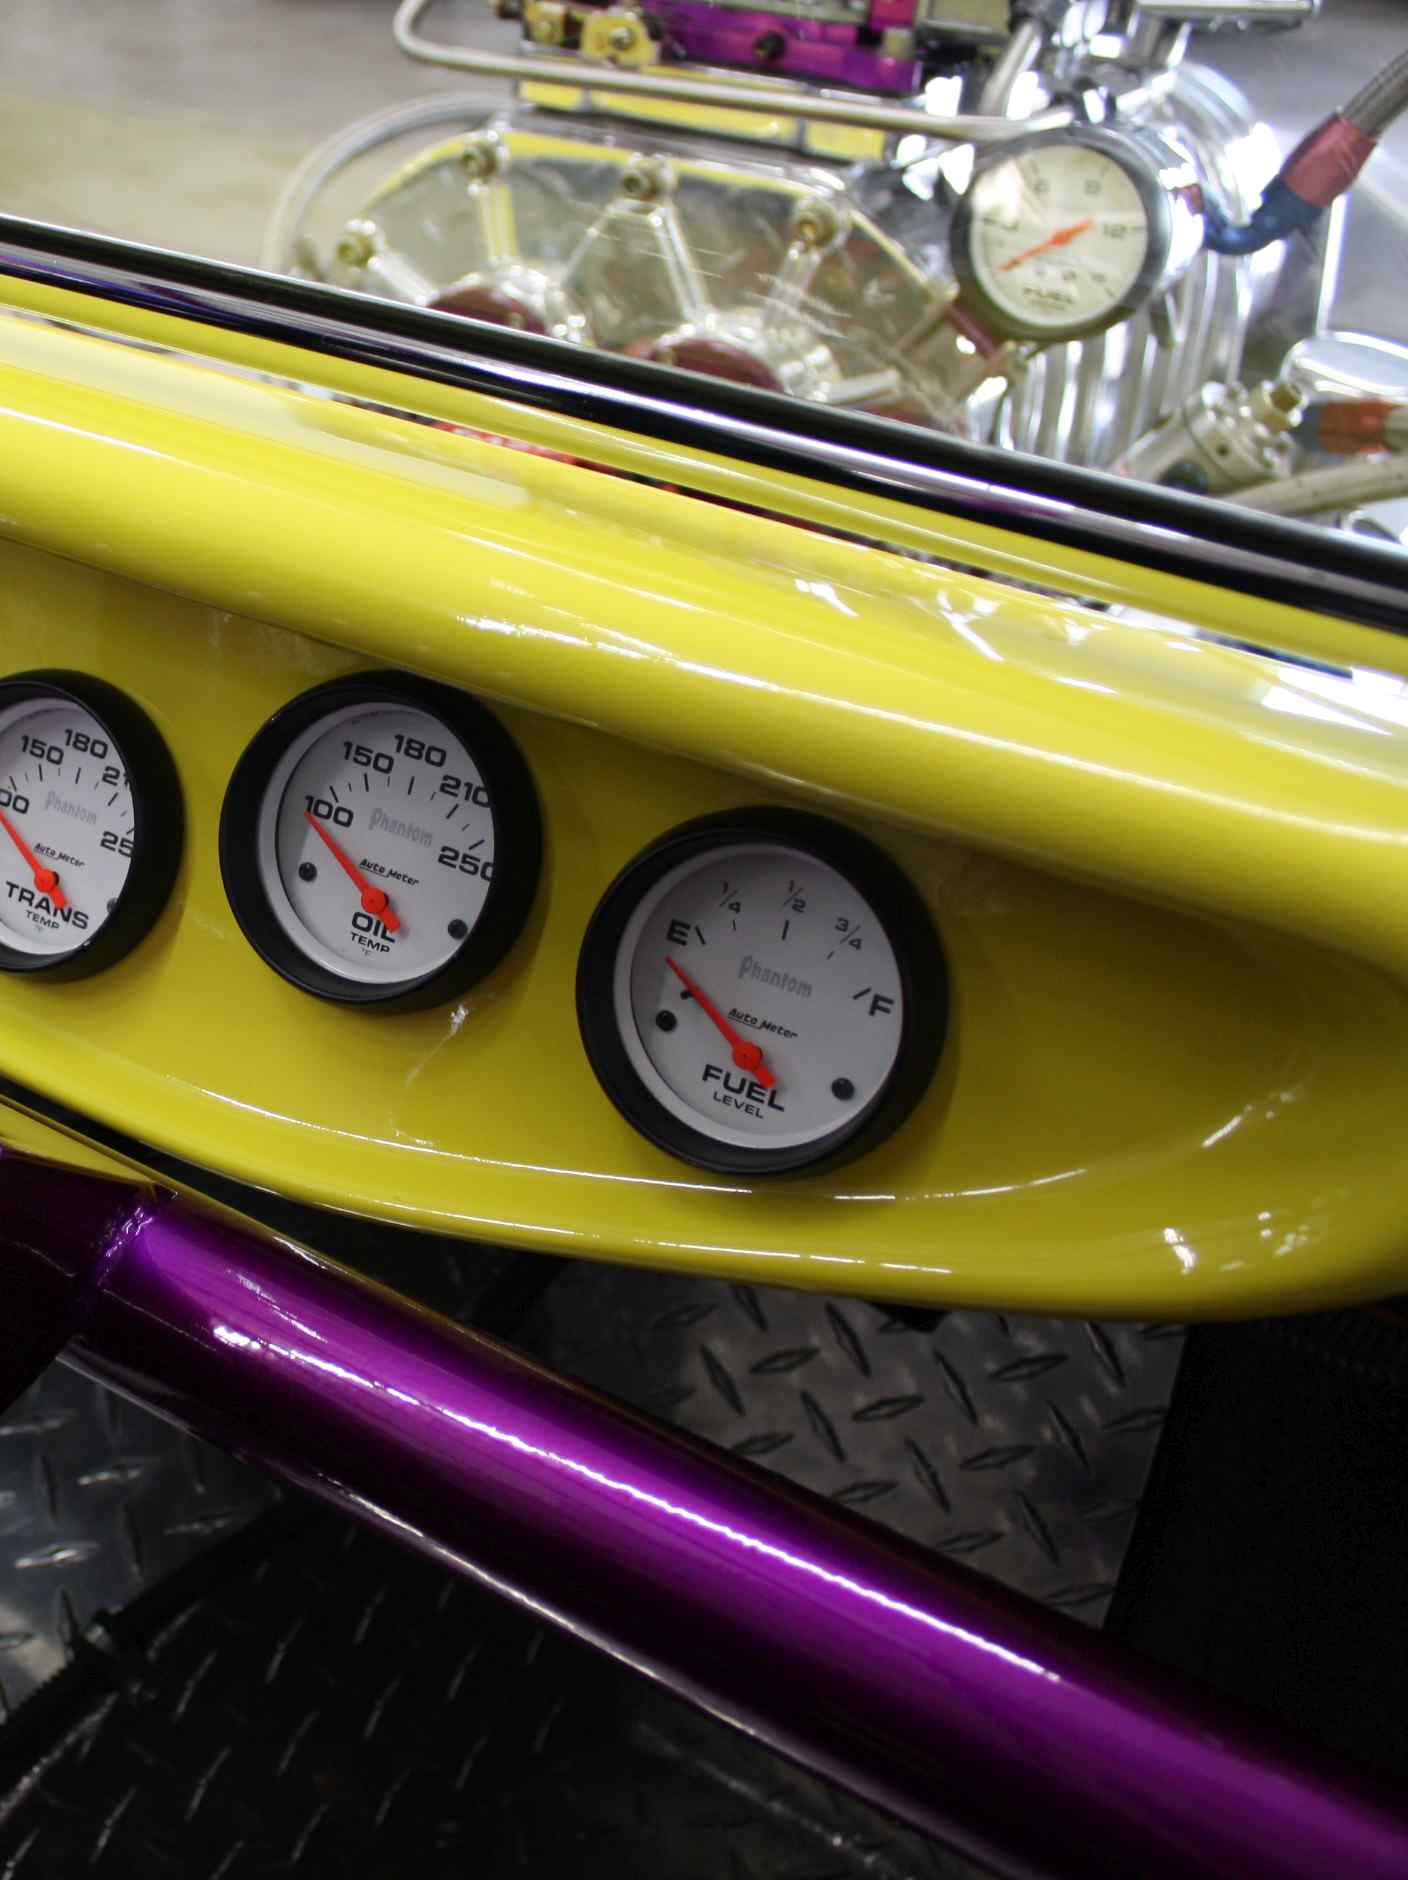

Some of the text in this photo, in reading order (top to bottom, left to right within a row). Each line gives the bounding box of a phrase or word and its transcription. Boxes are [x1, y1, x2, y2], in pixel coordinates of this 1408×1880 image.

[20, 734, 65, 766] 150
[64, 728, 109, 760] 180
[343, 740, 395, 775] 150
[394, 733, 448, 768] 180
[304, 794, 355, 828] 100
[368, 806, 435, 847] Phantom
[33, 841, 86, 868] Auto Meter
[359, 857, 420, 887] Auto Meter
[5, 880, 90, 930] TRANS
[718, 880, 742, 915] 1/4
[784, 879, 808, 913] 1/2
[25, 909, 60, 931] TEMP
[351, 910, 396, 944] OIL
[665, 918, 692, 946] E
[834, 917, 863, 951] 3/4
[350, 932, 391, 953] TEMP
[737, 954, 814, 1000] Phantom
[868, 993, 895, 1017] F
[728, 1007, 800, 1039] Auto Meter
[701, 1063, 786, 1113] FUEL
[713, 1090, 765, 1120] LEVEL
